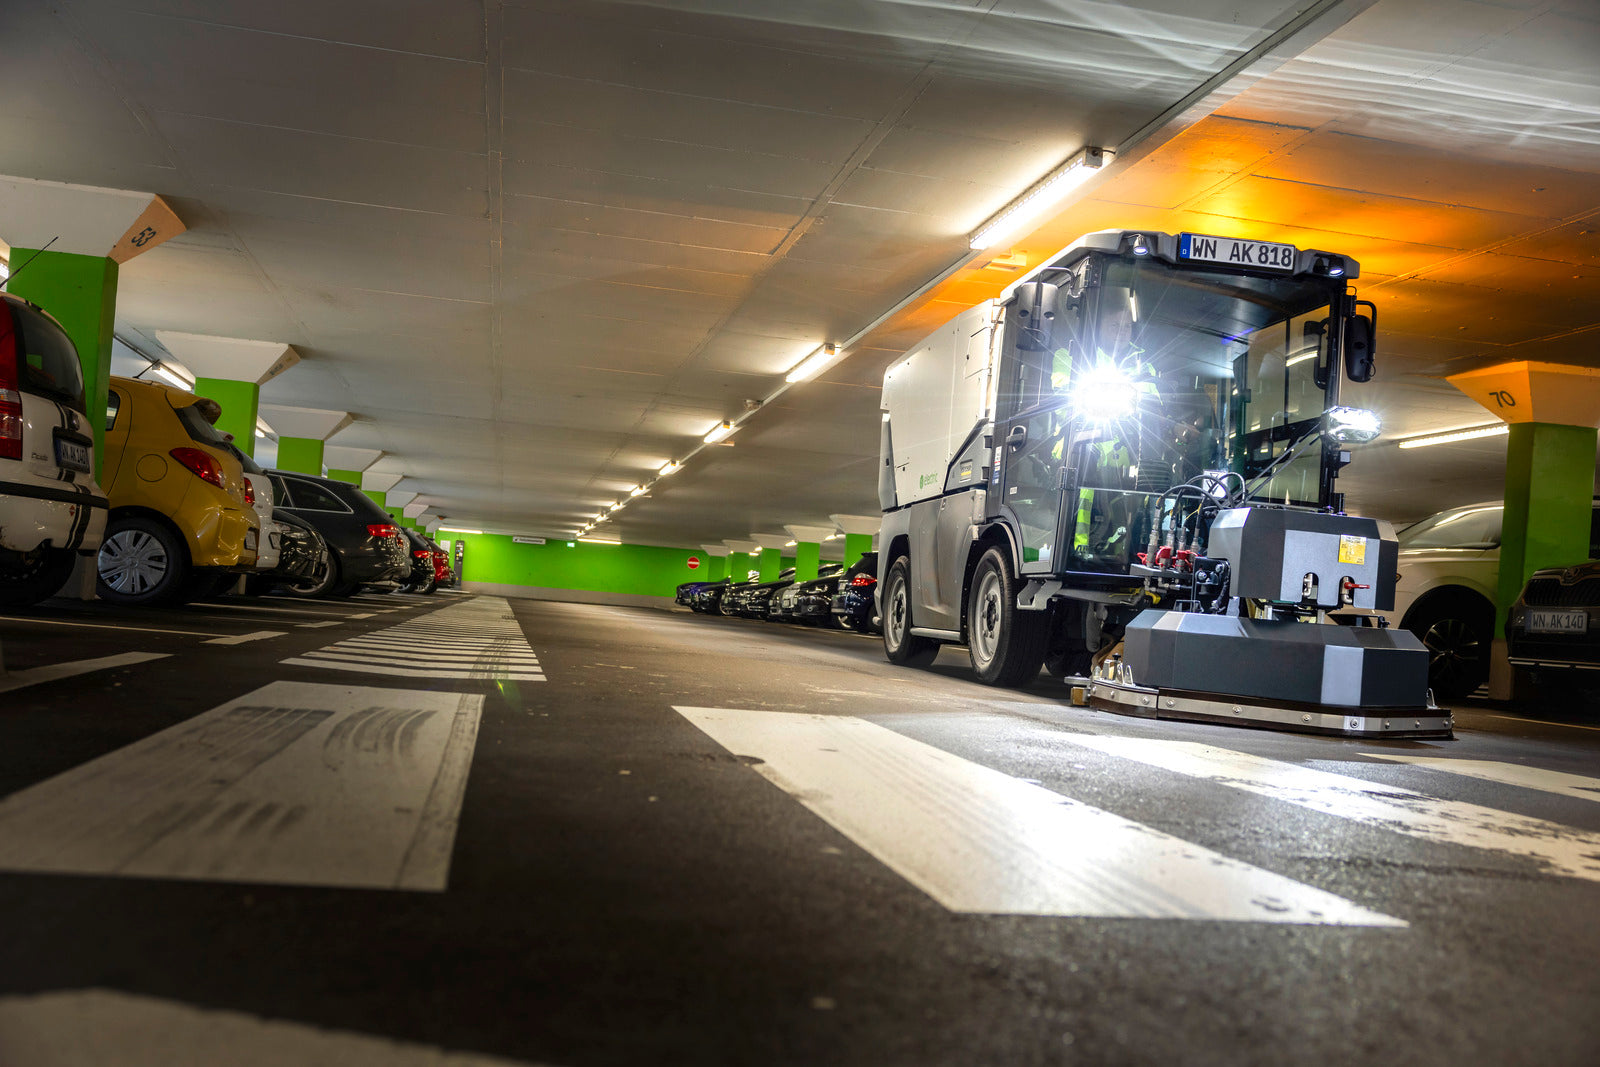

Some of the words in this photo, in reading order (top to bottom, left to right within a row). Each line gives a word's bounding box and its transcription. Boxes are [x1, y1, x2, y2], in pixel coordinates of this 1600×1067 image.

[131, 227, 156, 247] 53
[1192, 238, 1217, 259] WN
[1230, 243, 1254, 263] AK
[1258, 245, 1292, 267] 818
[1489, 391, 1515, 408] 70
[1532, 614, 1546, 628] WN
[1550, 614, 1564, 628] AK
[1565, 615, 1584, 629] 140
